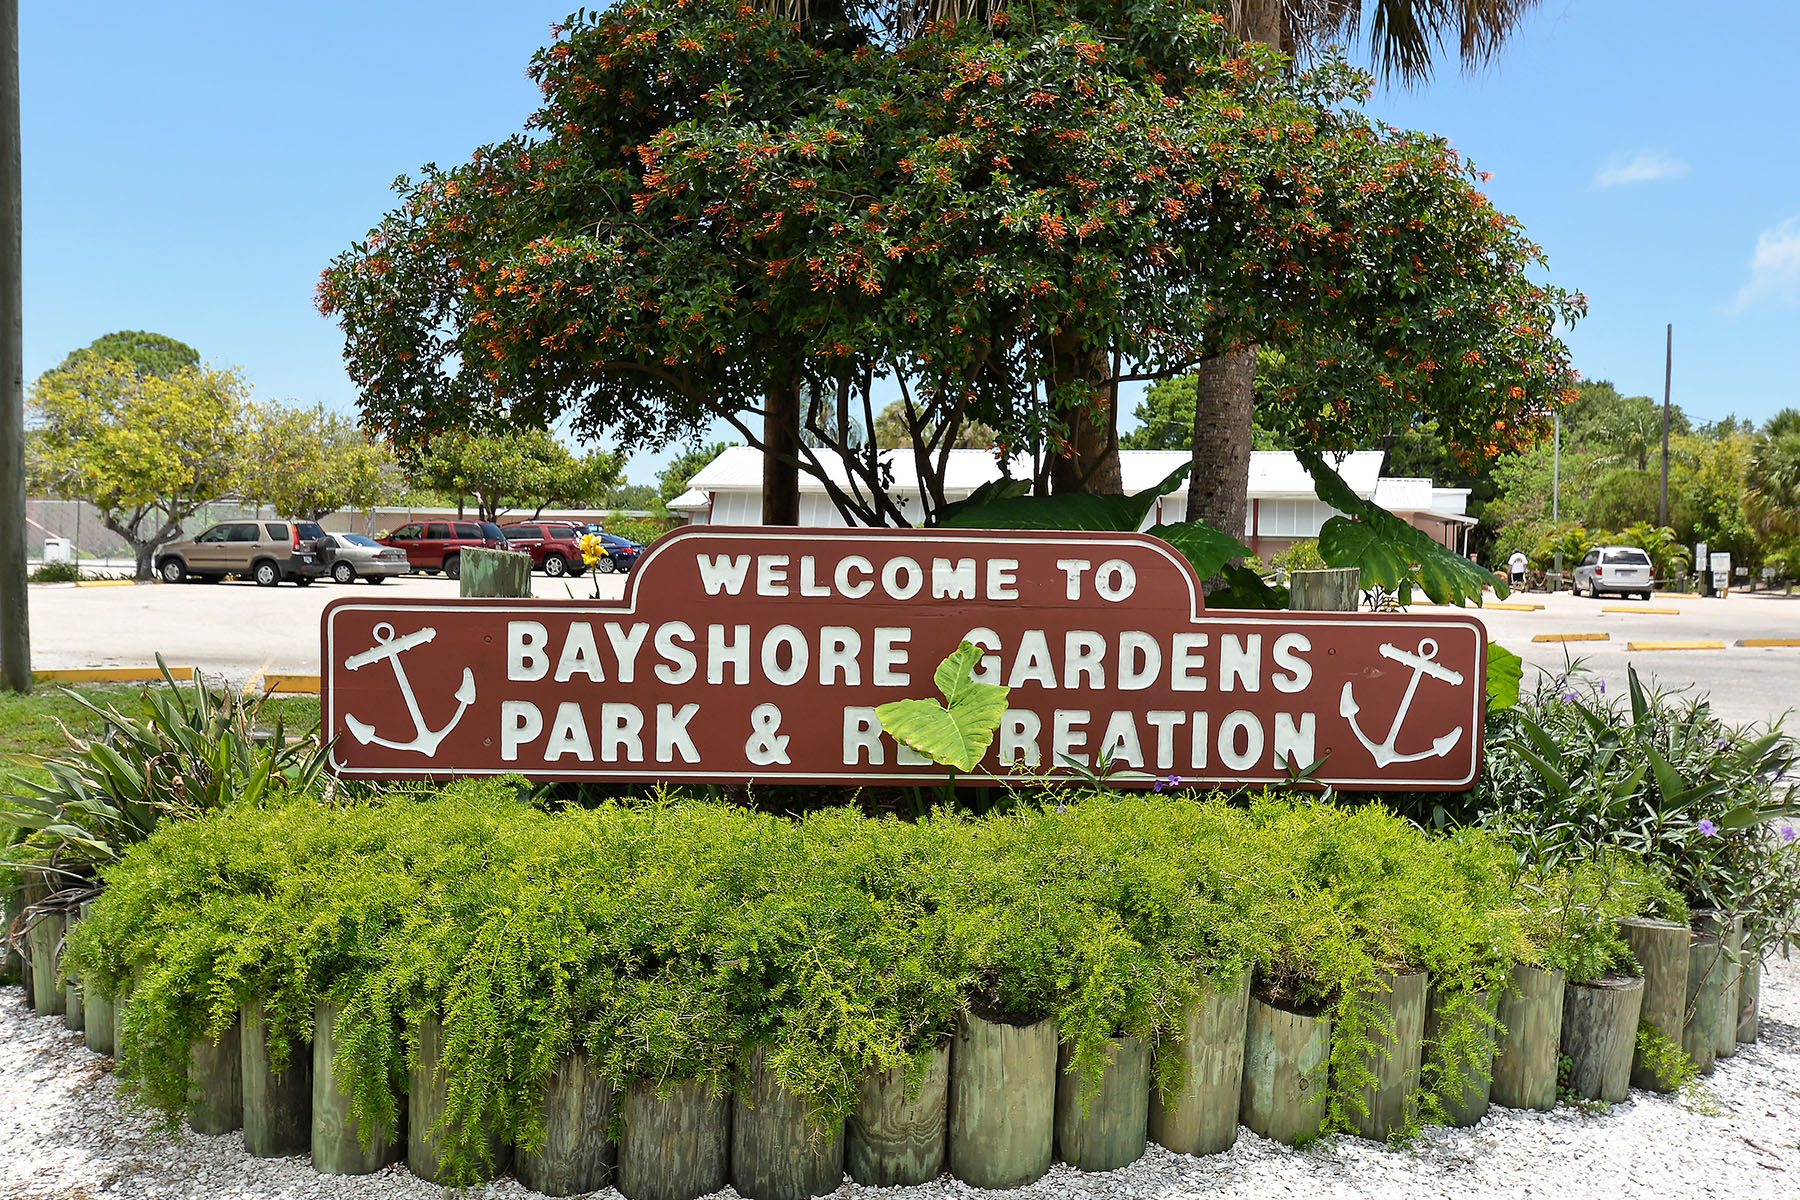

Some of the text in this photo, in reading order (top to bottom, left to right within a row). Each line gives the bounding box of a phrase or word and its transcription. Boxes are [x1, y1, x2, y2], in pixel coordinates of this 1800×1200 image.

[696, 553, 1138, 603] WELCOME TO
[506, 619, 1314, 694] BAYSHORE GARDENS
[500, 699, 1317, 772] PARK & RREATION
